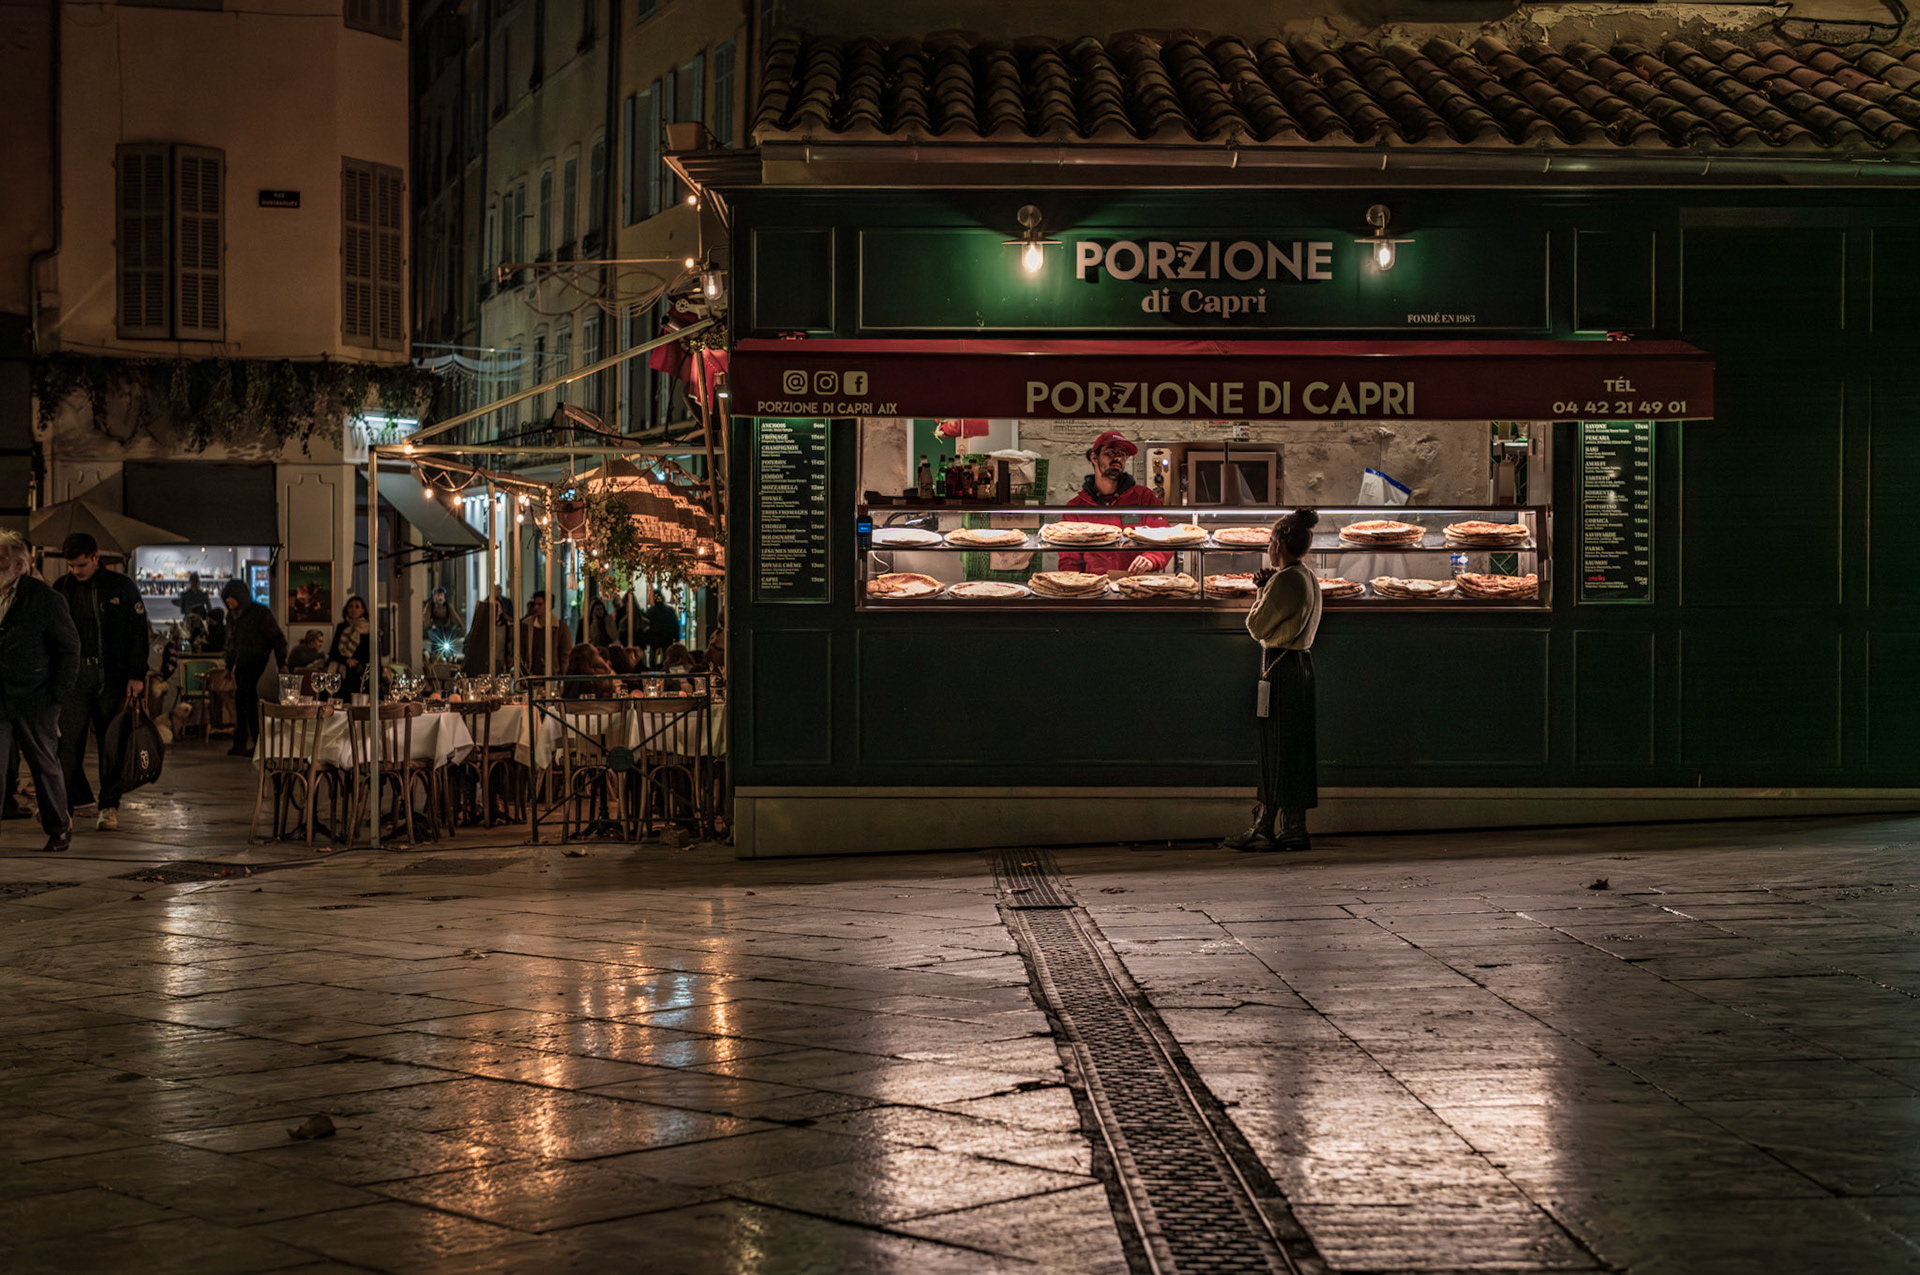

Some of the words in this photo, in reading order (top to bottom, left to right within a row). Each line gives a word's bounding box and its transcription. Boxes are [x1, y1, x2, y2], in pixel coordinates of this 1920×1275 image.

[1076, 240, 1333, 281] PORZIONE
[1141, 287, 1171, 313] di
[1180, 287, 1267, 319] Capri
[1407, 312, 1440, 323] FONDÉ
[1441, 314, 1455, 323] EN
[1603, 376, 1636, 392] TÉL
[1026, 381, 1244, 415] PORZIONE
[1258, 381, 1291, 414] DI
[1302, 381, 1415, 415] CAPRI
[757, 401, 818, 414] PORZIONE
[823, 402, 834, 414] DI
[837, 402, 873, 414] CAPRI
[878, 403, 898, 415] AIX
[1552, 401, 1579, 414] 04
[1584, 401, 1609, 414] 42
[1614, 401, 1633, 414] 21
[1638, 401, 1663, 414] 49
[1668, 400, 1687, 413] 01
